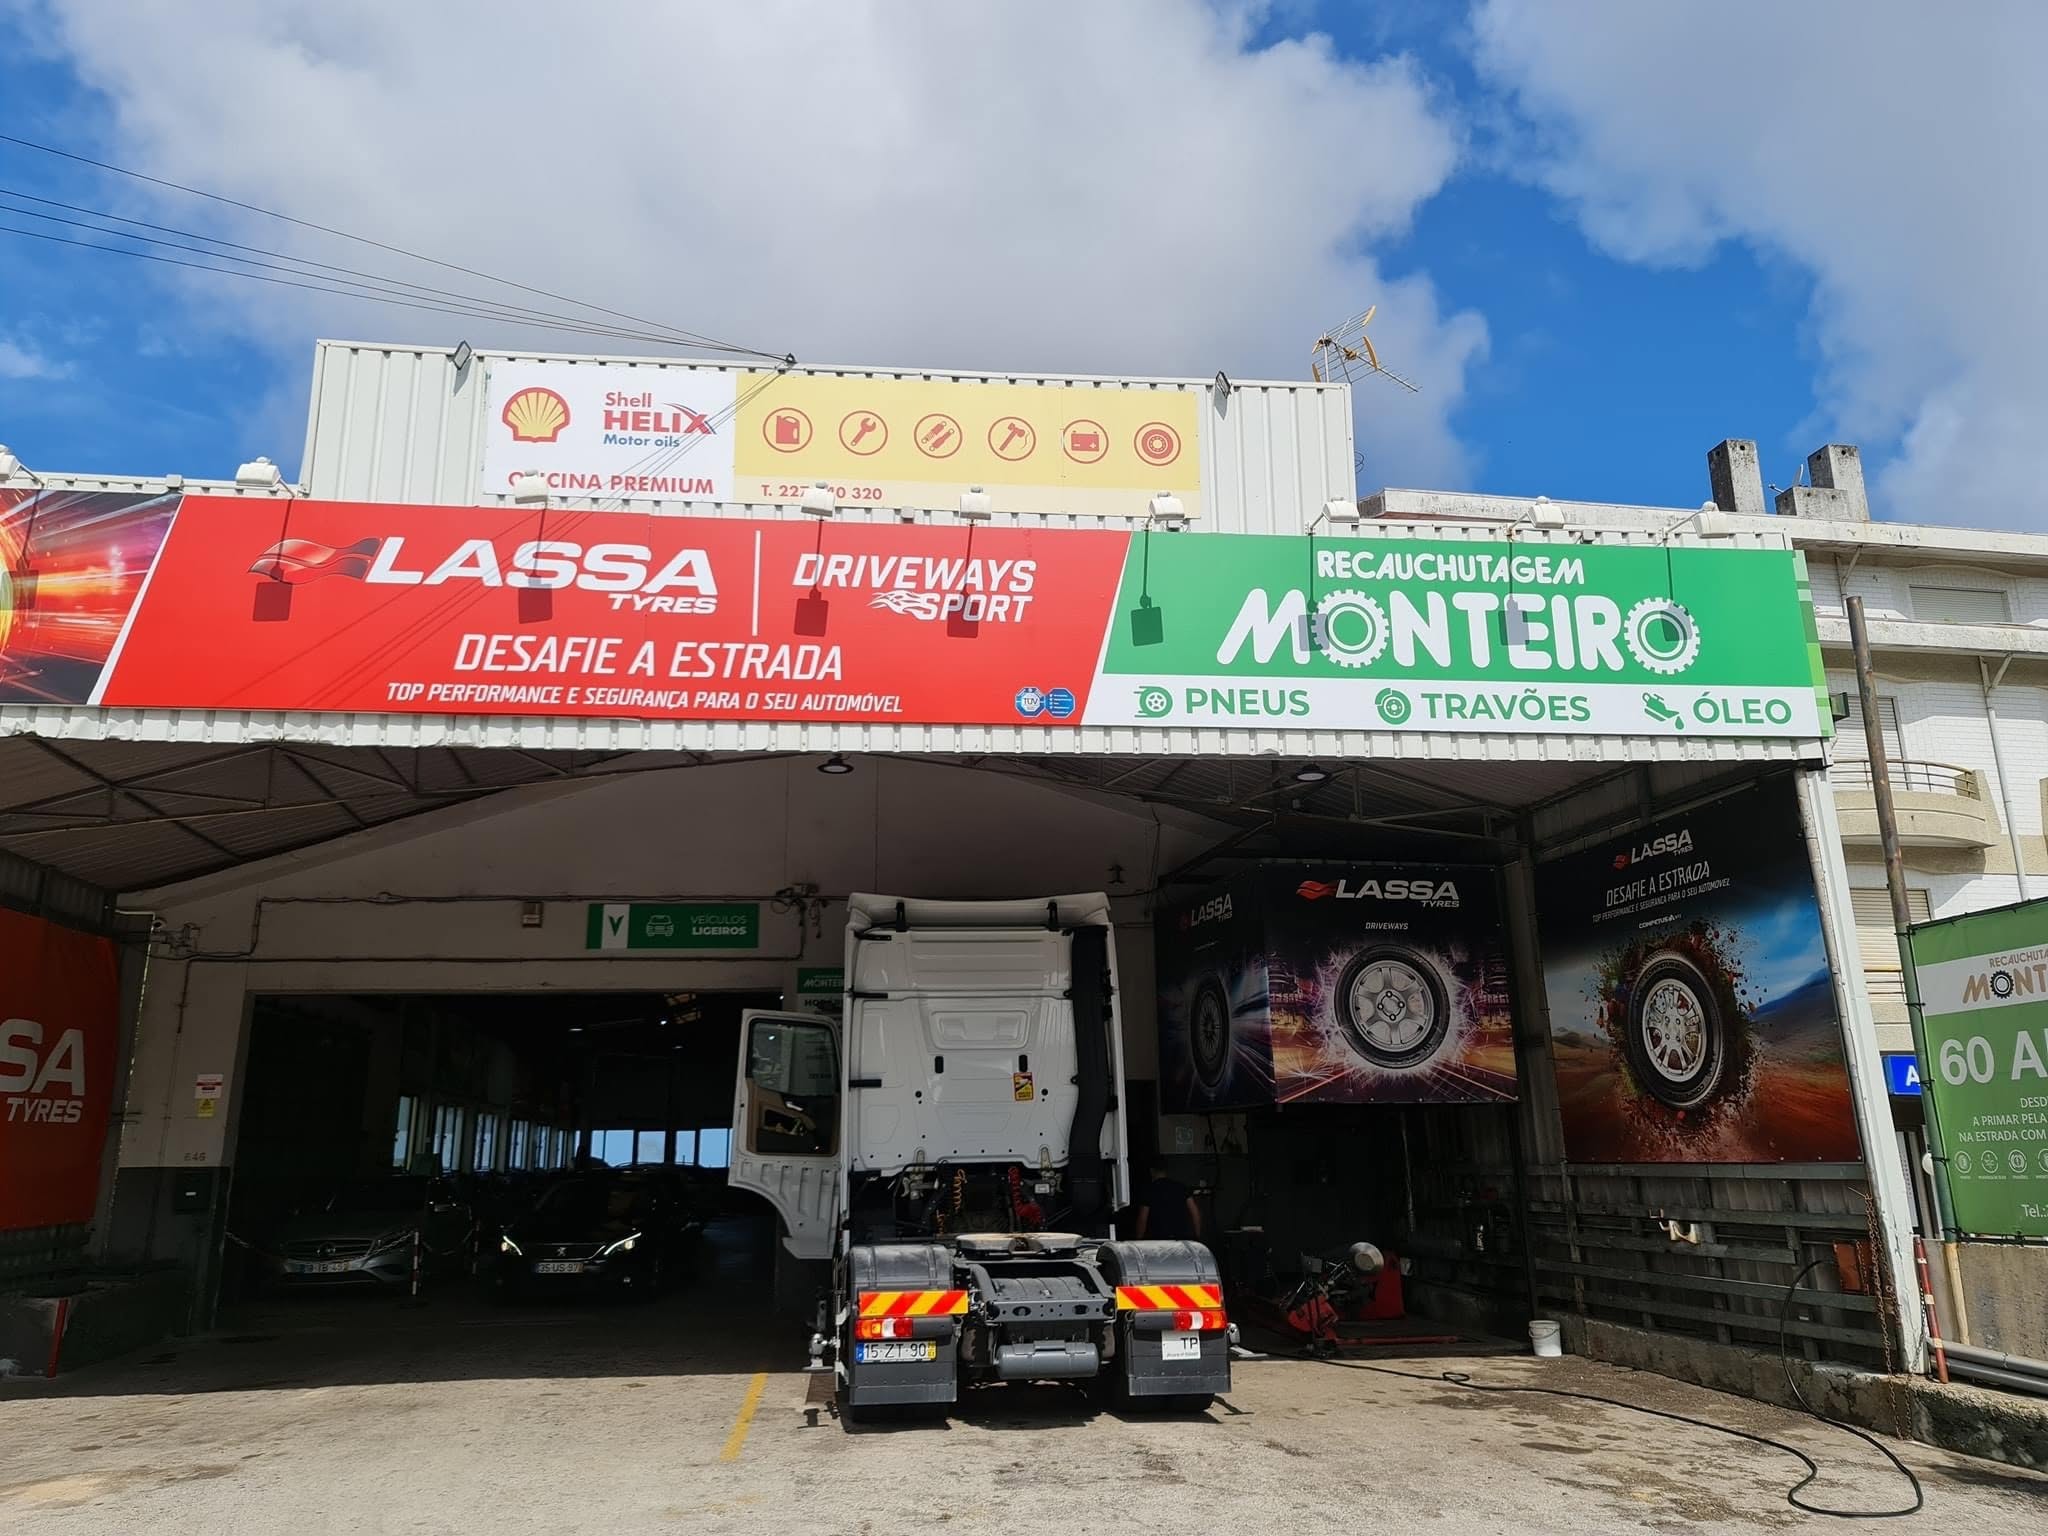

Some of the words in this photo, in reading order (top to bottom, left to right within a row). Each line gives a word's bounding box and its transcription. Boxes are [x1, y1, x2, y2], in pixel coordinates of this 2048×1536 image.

[605, 392, 652, 408] Shell
[603, 405, 714, 435] HELIX
[603, 434, 650, 447] Motor
[655, 436, 681, 448] oils
[508, 471, 602, 490] OCINA
[610, 475, 714, 494] PREMIUM
[761, 484, 772, 497] T.
[852, 487, 883, 500] 320
[365, 536, 719, 596] LASSA
[792, 553, 1037, 593] DRIVEWAYS
[1317, 550, 1585, 586] RECAUCHUTAGEM
[607, 592, 718, 614] TYRES
[918, 593, 1033, 623] SPORT
[1216, 588, 1701, 676] MONTEIRO
[454, 633, 623, 675] DESAFIE
[627, 640, 656, 677] A
[668, 642, 843, 681] ESTRADA
[387, 682, 424, 701] TOP
[427, 683, 563, 705] PERFORMANCE
[566, 686, 581, 705] E
[583, 687, 689, 710] SEGURANÇA
[693, 691, 741, 709] PARA
[745, 692, 759, 710] O
[763, 693, 798, 711] SEU
[801, 691, 903, 713] AUTOMÓVEL
[1185, 688, 1311, 716] PNEUS
[1420, 688, 1591, 722] TRAVÕES
[1692, 691, 1792, 725] ÓLEO
[1631, 829, 1693, 864] LASSA
[1335, 879, 1460, 901] LASSA
[1606, 880, 1647, 908] DESAFIE
[1649, 876, 1657, 895] A
[1659, 861, 1710, 892] ESTRADA
[1191, 893, 1233, 928] LASSA
[1421, 900, 1460, 908] TYRES
[691, 926, 748, 936] LIGEIROS
[1365, 921, 1409, 931] DRIVEWAYS
[1962, 964, 2048, 1004] MONT
[0, 1018, 85, 1097] SA
[1940, 1036, 1995, 1085] 60
[7, 1097, 84, 1124] TYRES
[2020, 1096, 2048, 1109] DESD
[1973, 1116, 1980, 1127] A
[1981, 1114, 2020, 1126] PRIMAR
[2021, 1112, 2048, 1124] PELA
[1958, 1132, 1974, 1143] NA
[1975, 1130, 2019, 1142] ESTRADA
[2020, 1129, 2047, 1140] COM
[1180, 1337, 1198, 1350] TP
